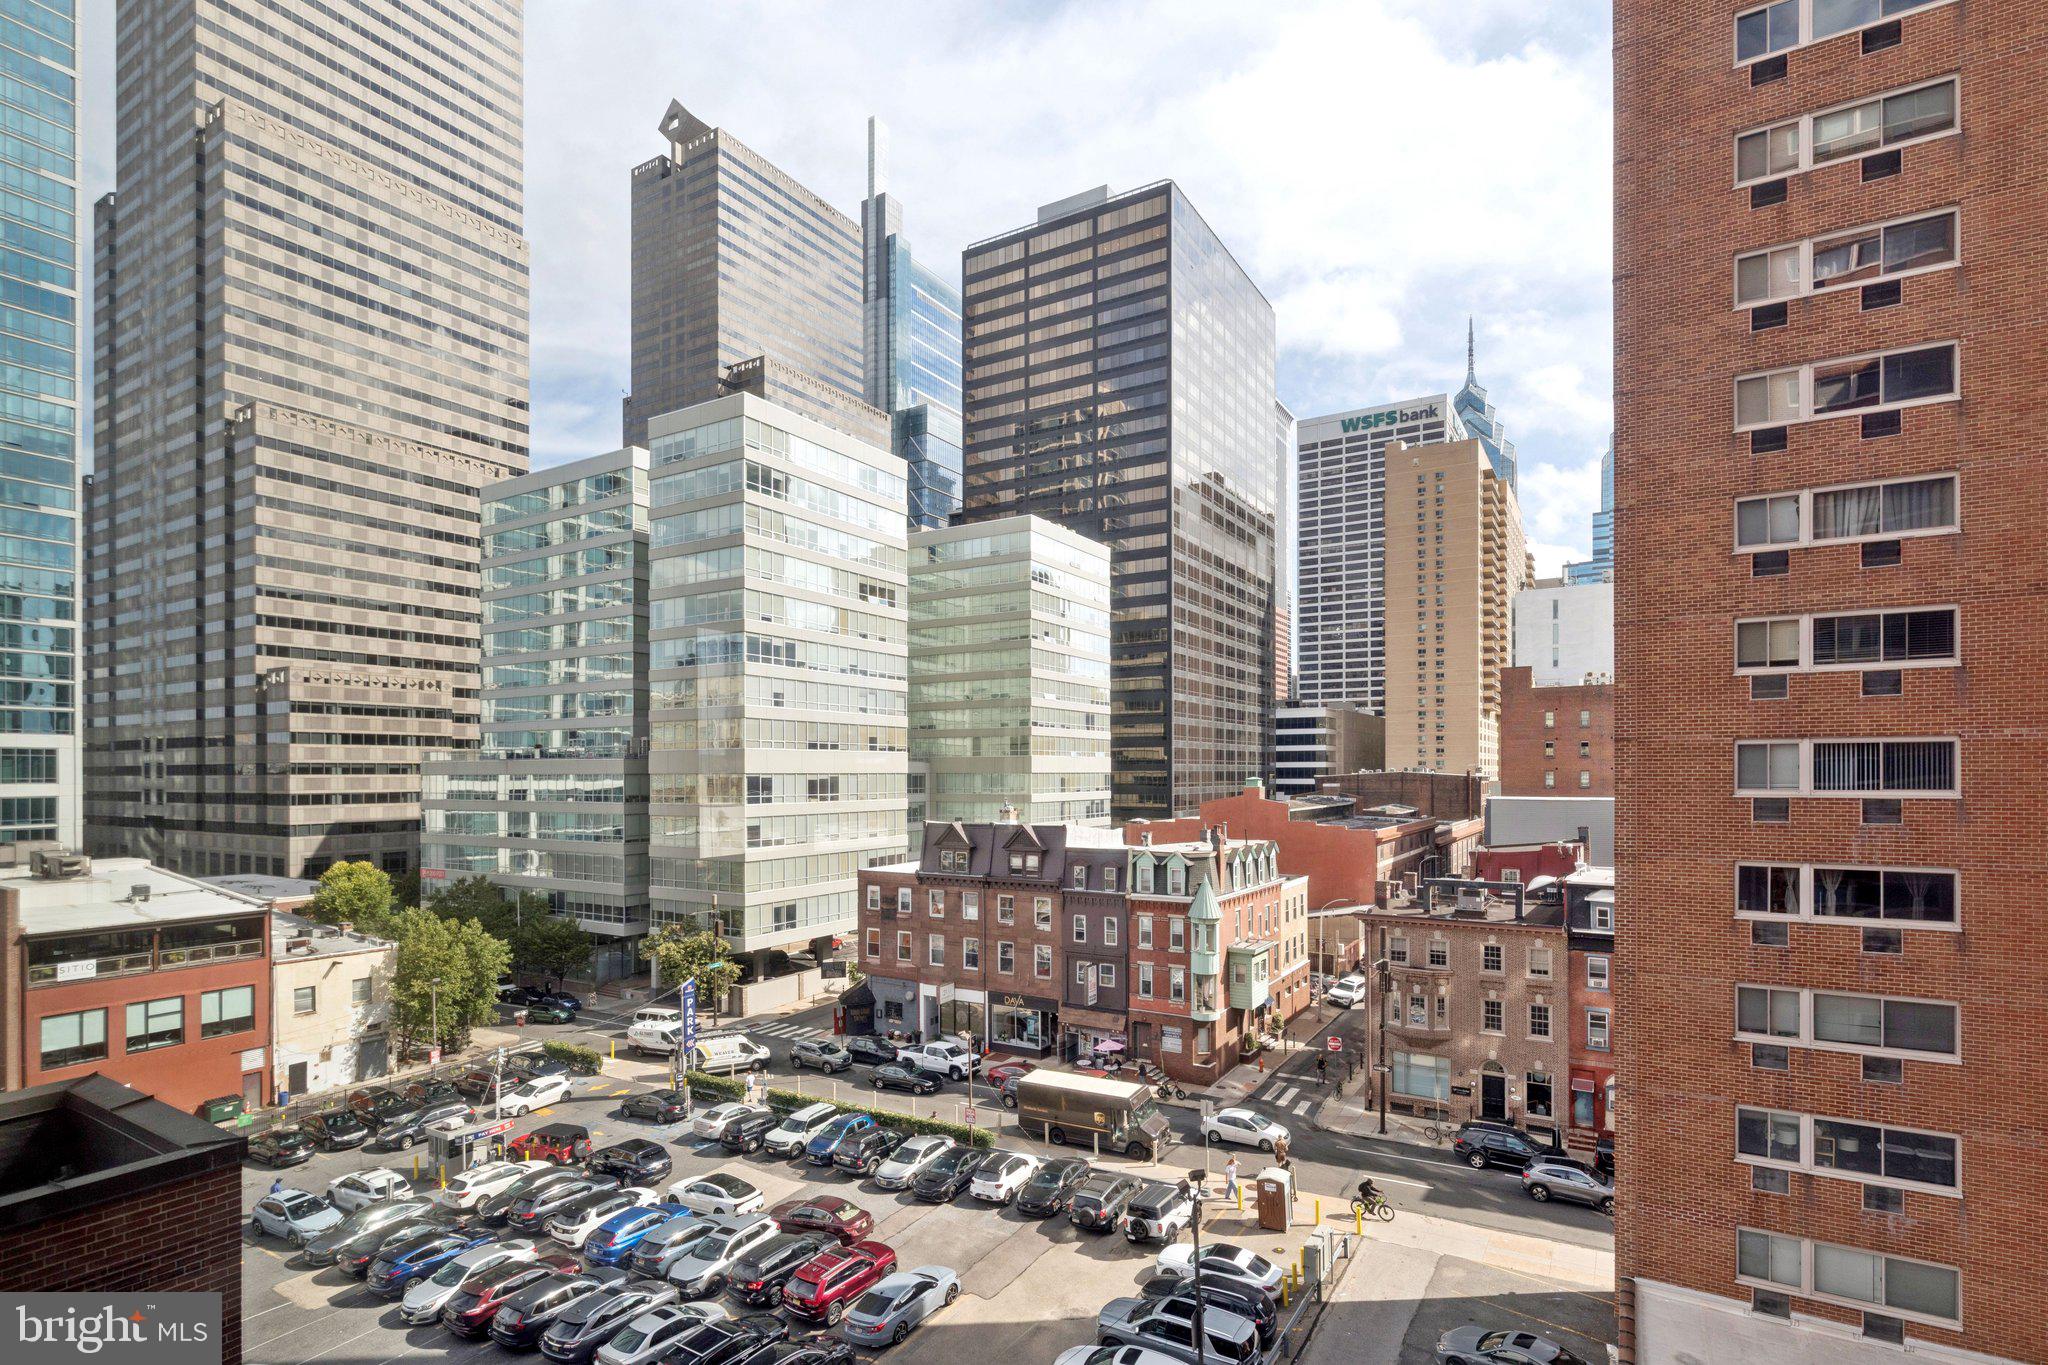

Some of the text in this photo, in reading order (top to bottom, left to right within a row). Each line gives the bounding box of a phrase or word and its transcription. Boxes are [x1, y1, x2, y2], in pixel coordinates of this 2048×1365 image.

[1341, 404, 1439, 433] WSFS bank
[59, 963, 95, 975] SITIO
[1004, 995, 1025, 1008] DAVA
[686, 998, 695, 1035] PARK
